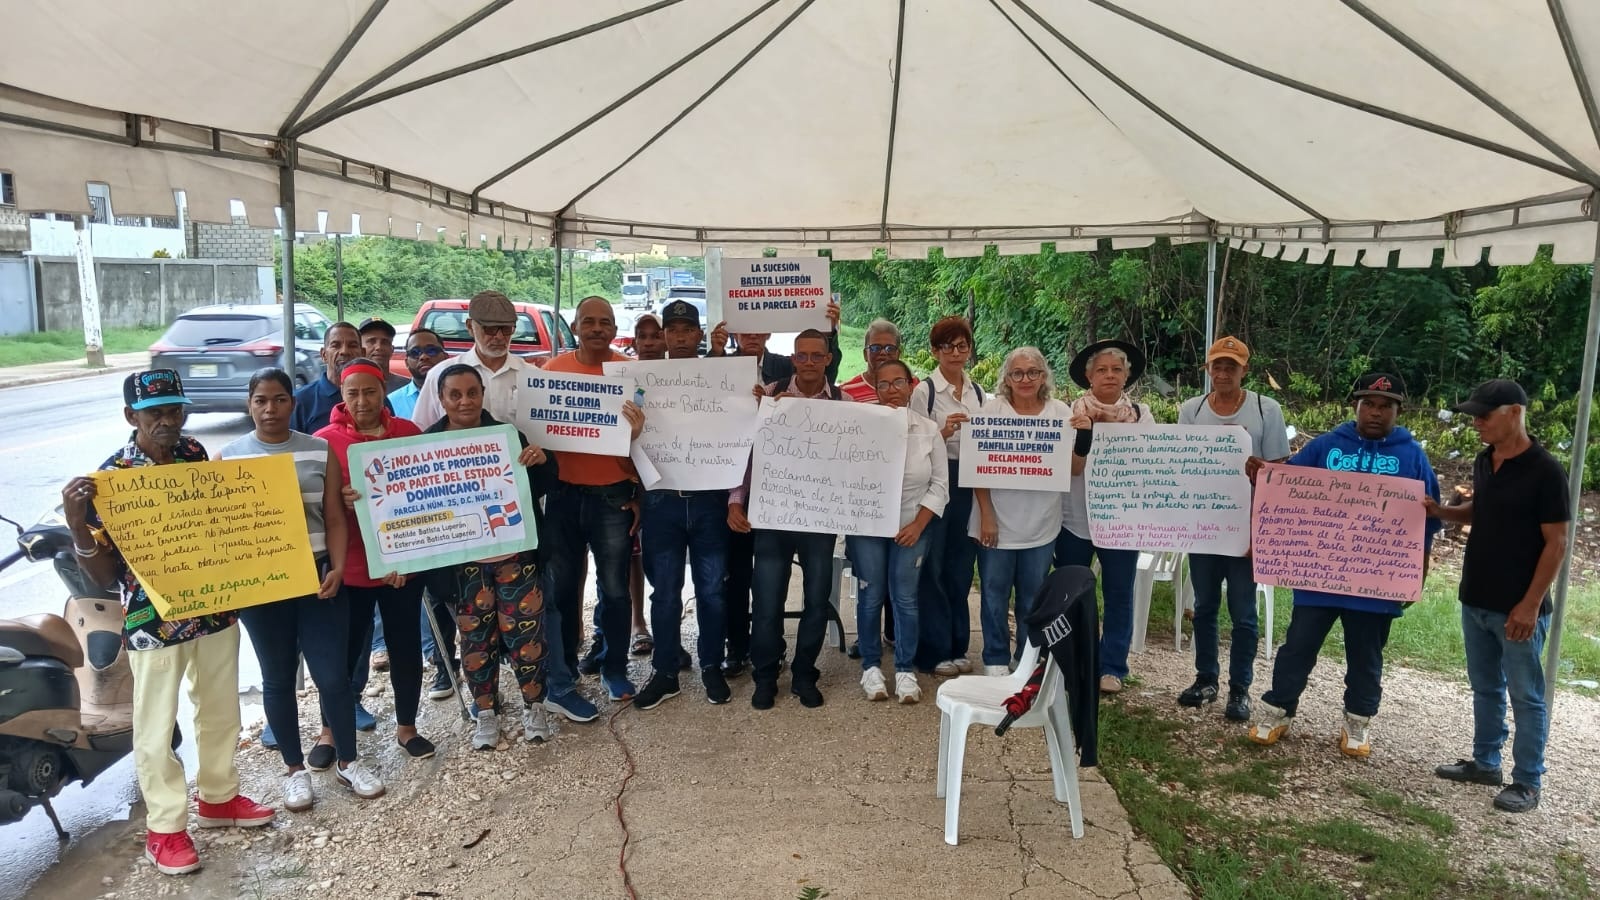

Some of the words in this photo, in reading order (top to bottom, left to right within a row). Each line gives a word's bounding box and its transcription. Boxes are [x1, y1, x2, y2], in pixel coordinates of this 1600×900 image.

[751, 264, 760, 272] LA
[764, 262, 800, 272] SUCESIÓN
[740, 276, 772, 286] BATISTA
[775, 274, 811, 284] LUPERÓN
[729, 289, 765, 298] RECLAMA
[768, 288, 782, 297] SUS
[784, 288, 824, 296] DERECHOS
[738, 302, 748, 310] DE
[751, 302, 760, 310] LA
[763, 300, 798, 310] PARCELA
[800, 300, 816, 308] #25
[528, 378, 545, 388] LOS
[548, 379, 624, 395] DESCENDIENTES
[720, 374, 736, 392] de
[550, 394, 562, 405] DE
[565, 396, 600, 408] GLORIA
[680, 394, 728, 414] Batista
[530, 408, 570, 420] BATISTA
[573, 412, 618, 424] LUPERÓN
[764, 402, 792, 428] La
[800, 406, 864, 435] Sucesión
[970, 417, 985, 426] LOS
[988, 418, 1050, 427] DESCENDIENTES
[1052, 420, 1064, 428] DE
[546, 424, 600, 438] PRESENTES
[972, 428, 990, 438] JOSÉ
[992, 430, 1024, 439] BATISTA
[1028, 431, 1032, 439] Y
[1036, 432, 1060, 440] JUANA
[672, 435, 682, 451] de
[758, 427, 822, 460] Batista
[828, 436, 890, 464] Luperón
[1016, 442, 1054, 452] LUPERÓN
[391, 455, 411, 470] ¡NO
[412, 454, 420, 464] A
[422, 451, 434, 462] LA
[435, 444, 482, 460] VIOLACIÓN
[484, 442, 502, 454] DEL
[988, 454, 1042, 464] RECLAMAMOS
[388, 465, 430, 482] DERECHO
[434, 462, 445, 472] DE
[448, 454, 500, 470] PROPIEDAD
[762, 462, 834, 487] Reclamamos
[976, 466, 1017, 475] NUESTRAS
[1020, 467, 1052, 476] TIERRAS
[1092, 468, 1108, 478] NO
[102, 474, 184, 498] Justicia
[186, 467, 225, 488] Para
[386, 483, 406, 496] POR
[410, 478, 441, 490] PARTE
[444, 474, 462, 486] DEL
[465, 467, 502, 482] ESTADO
[406, 478, 486, 503] DOMINICANO!
[1277, 473, 1324, 488] Justicia
[1376, 483, 1418, 502] Familia
[761, 478, 806, 499] derechos
[812, 488, 824, 502] de
[830, 492, 843, 505] los
[1288, 488, 1331, 502] Batista
[1336, 493, 1378, 509] Luperón
[103, 496, 161, 517] Familia
[167, 488, 208, 505] Batista
[394, 505, 425, 517] PARCELA
[427, 500, 445, 512] NÚM.
[448, 498, 459, 508] 25,
[460, 496, 473, 506] D.C.
[475, 493, 493, 504] NÚM.
[759, 495, 778, 510] que
[150, 514, 162, 525] al
[758, 511, 770, 524] de
[777, 512, 809, 528] ellas
[814, 519, 859, 532] mismas
[1312, 506, 1350, 519] Batista
[1392, 518, 1404, 526] al
[394, 528, 416, 540] Matilde
[418, 525, 440, 536] Batista
[442, 521, 466, 534] Luperón
[394, 537, 425, 549] Estervina
[427, 533, 450, 544] Batista
[452, 530, 476, 542] Luperón
[1274, 528, 1286, 536] 20
[1316, 540, 1346, 552] Basta
[178, 588, 195, 603] ya
[200, 584, 216, 596] de
[266, 570, 290, 582] sin
